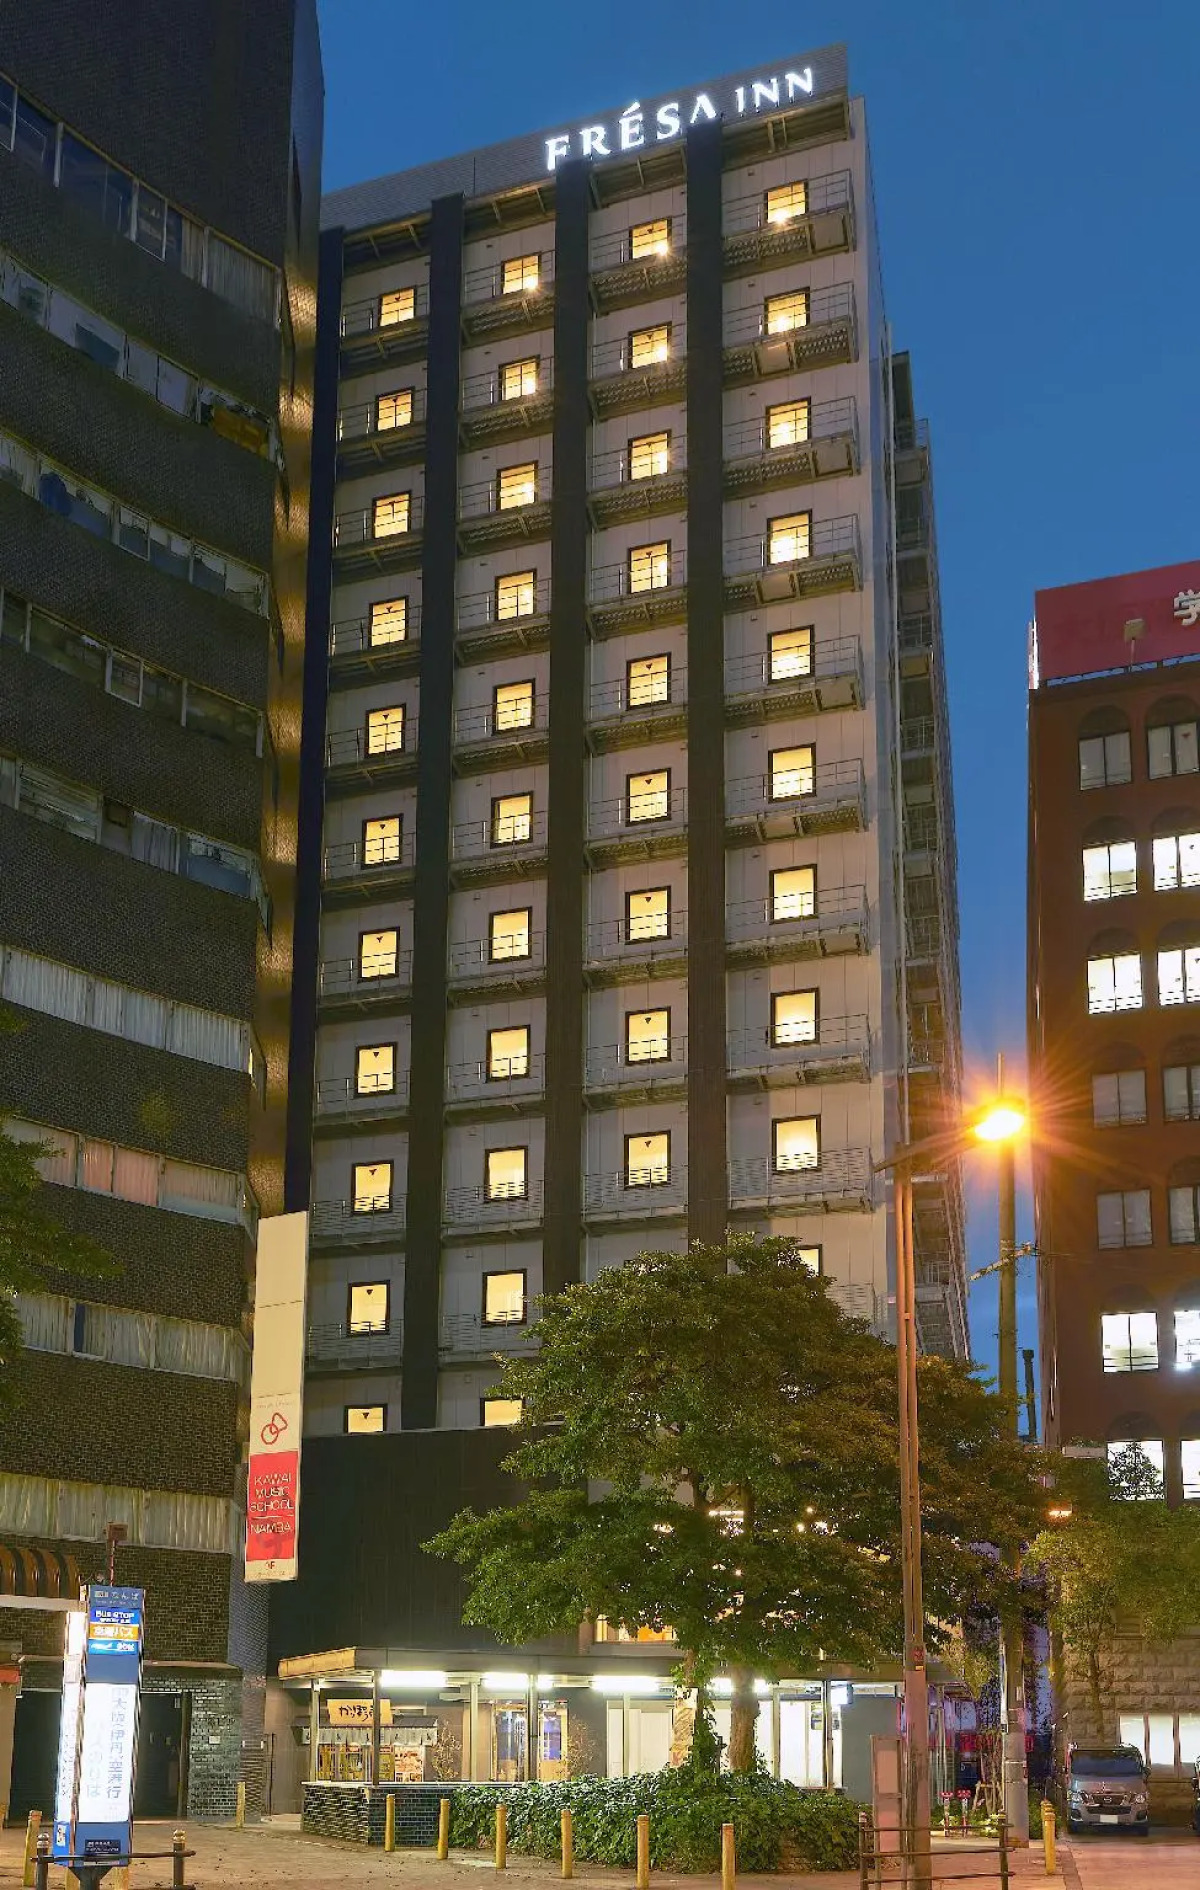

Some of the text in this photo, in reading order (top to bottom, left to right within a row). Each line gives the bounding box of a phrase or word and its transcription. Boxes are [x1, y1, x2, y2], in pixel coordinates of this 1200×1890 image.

[545, 67, 813, 171] FRÉSA INN
[254, 1473, 292, 1486] KAWAI
[255, 1486, 290, 1499] MUSIC
[249, 1499, 294, 1512] SCHOOL
[250, 1521, 291, 1535] NAMBA
[95, 1610, 135, 1619] BUS STOP
